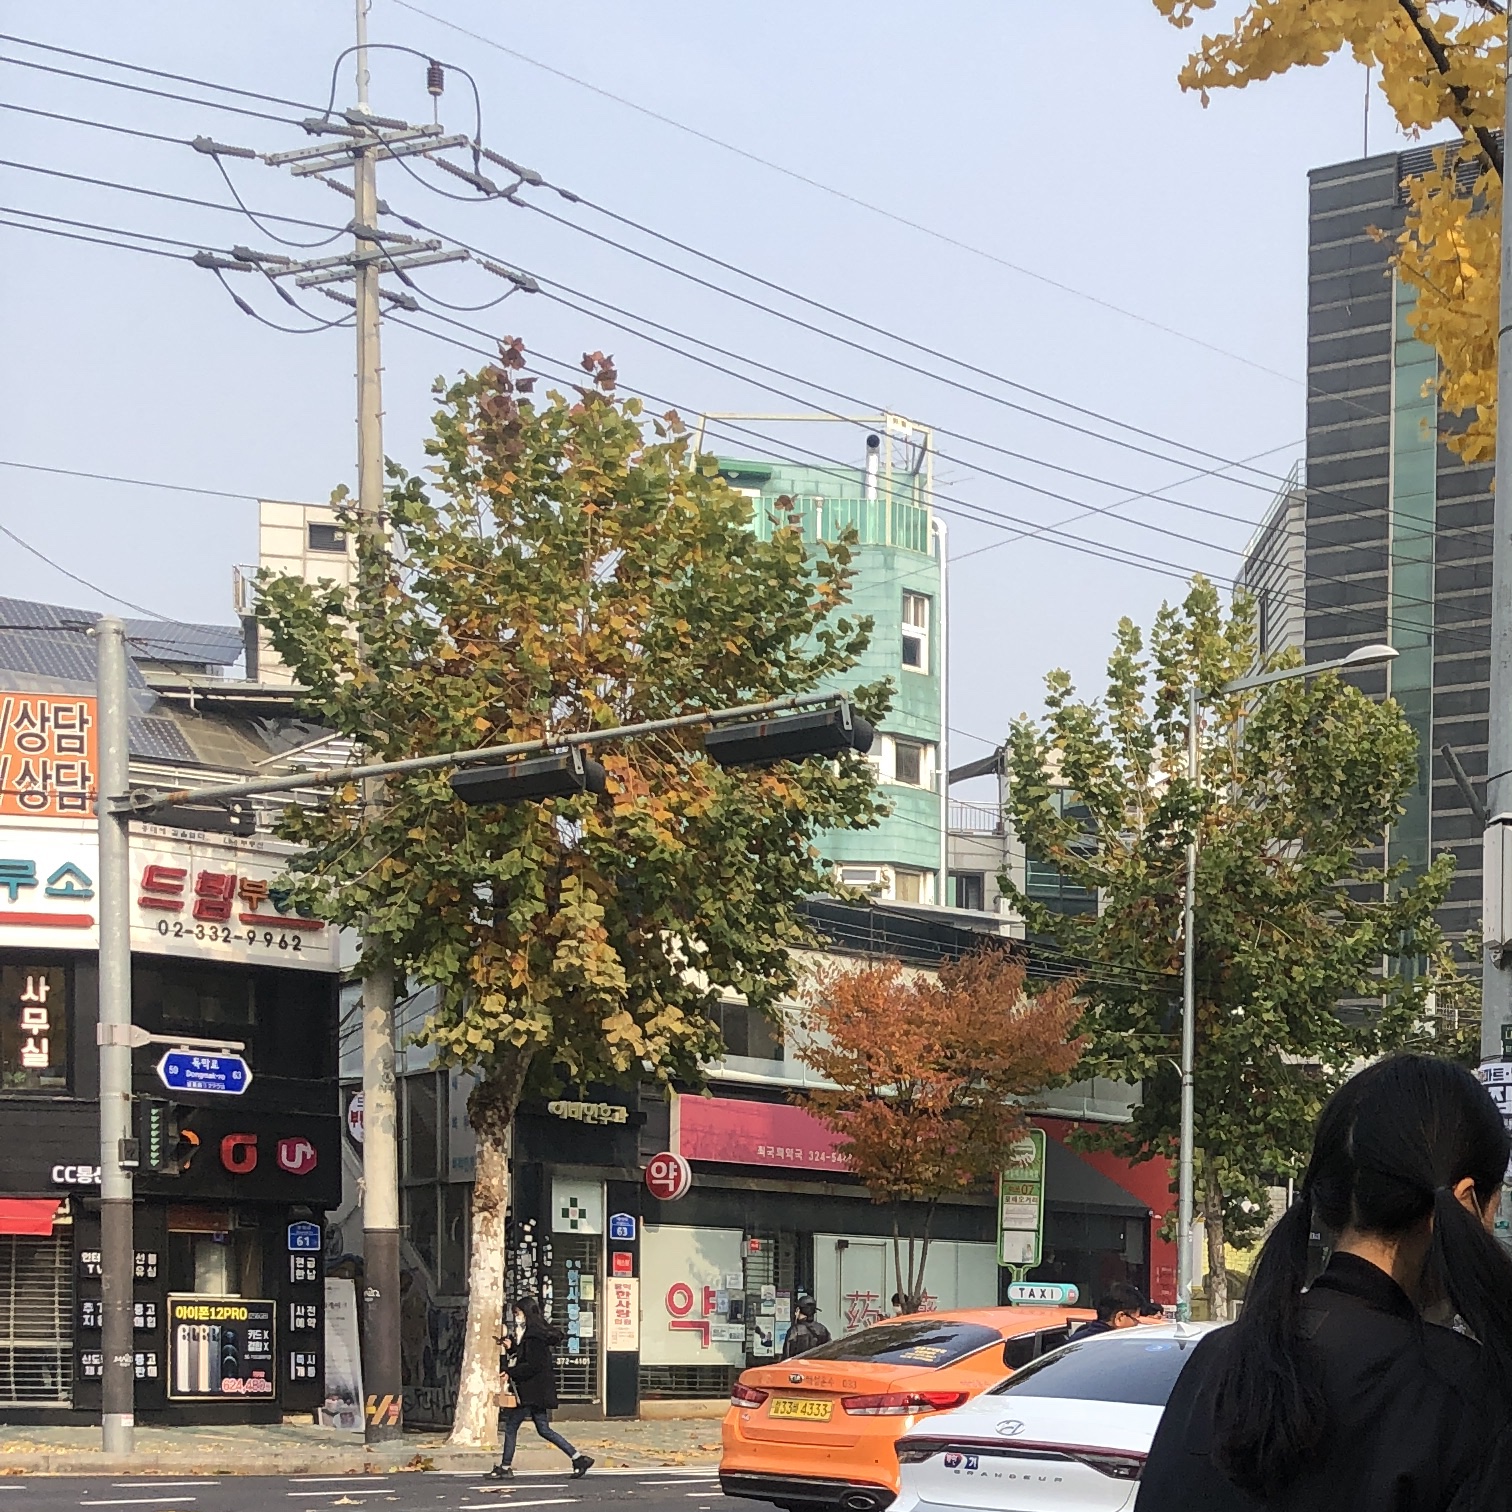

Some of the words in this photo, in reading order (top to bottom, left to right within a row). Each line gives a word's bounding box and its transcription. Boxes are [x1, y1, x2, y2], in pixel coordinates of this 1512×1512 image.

[157, 919, 303, 952] 02-332-9962
[20, 975, 51, 1068] 사무실
[650, 1161, 678, 1192] 약
[296, 1236, 310, 1247] 61
[1018, 1287, 1054, 1300] TAXI
[175, 1305, 248, 1321] 아이폰12PRO
[665, 1282, 716, 1349] 약
[800, 1402, 829, 1417] 4333
